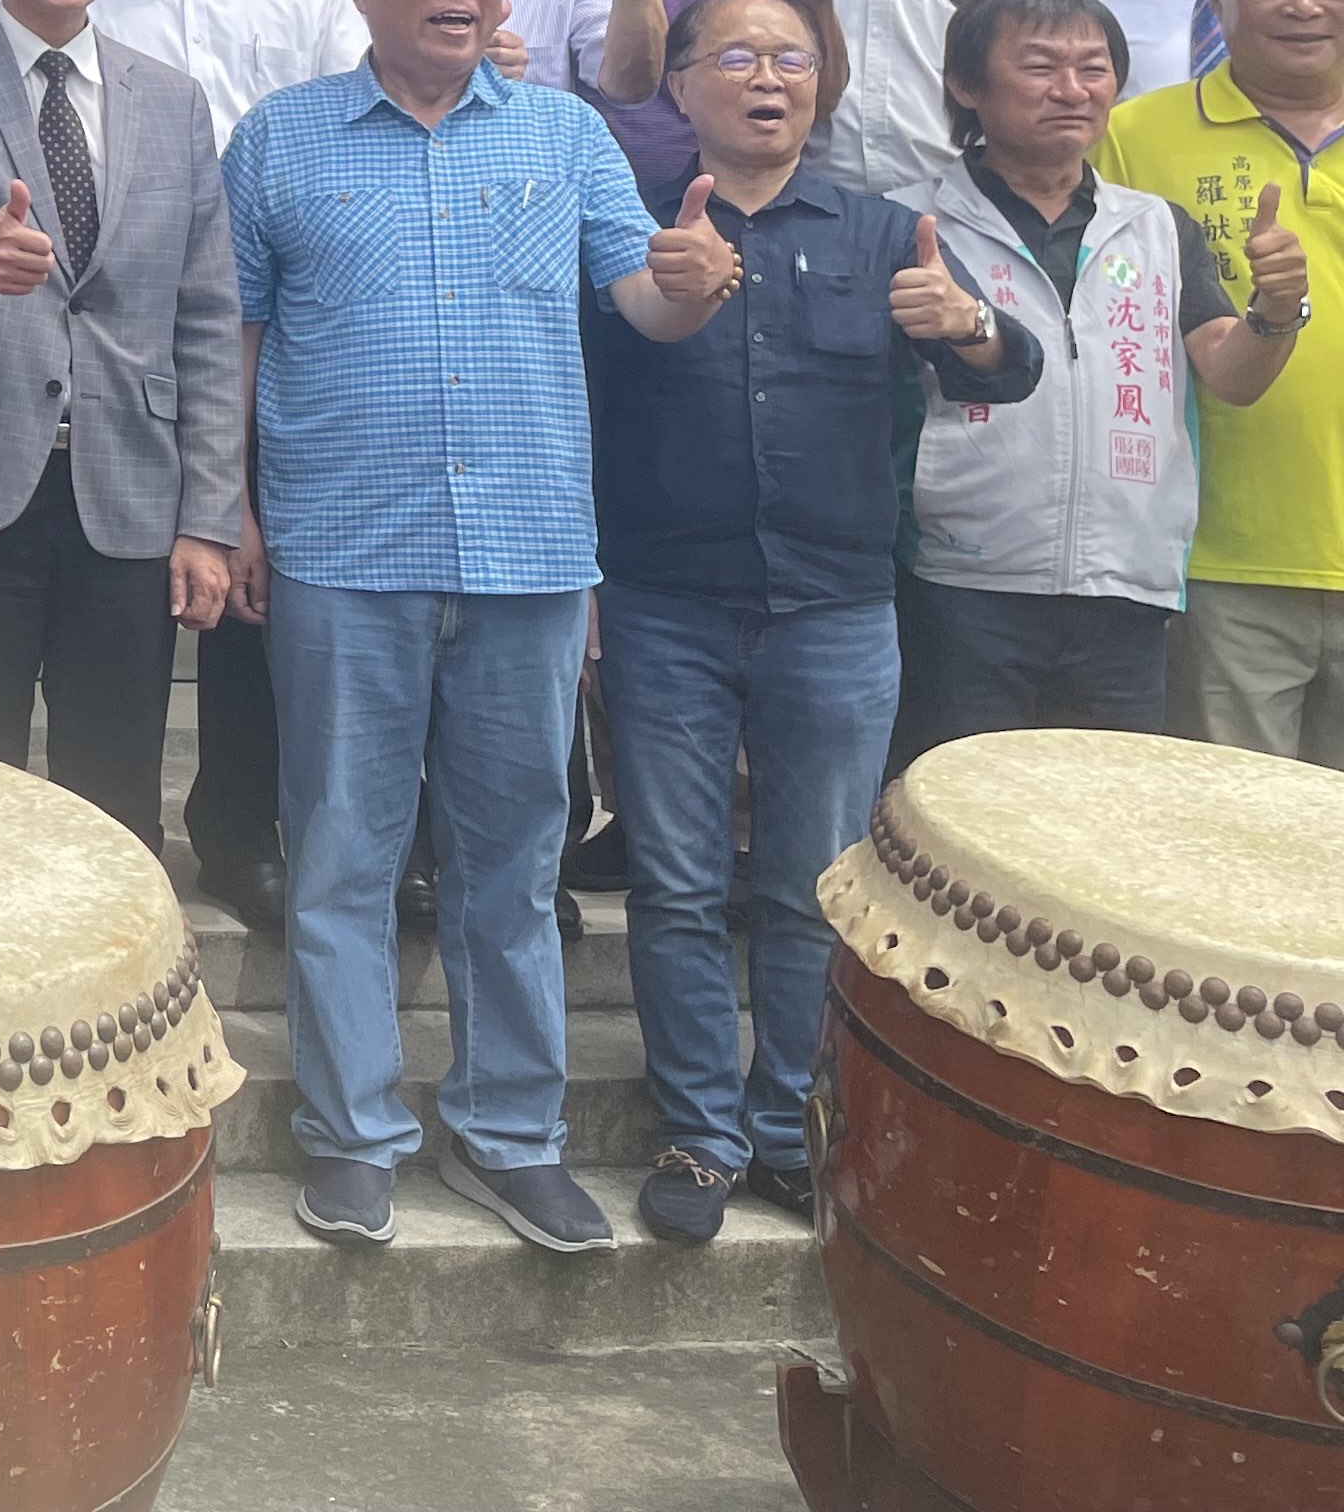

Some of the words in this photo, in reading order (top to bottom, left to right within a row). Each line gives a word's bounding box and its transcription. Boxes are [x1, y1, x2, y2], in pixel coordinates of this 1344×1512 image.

[990, 263, 1020, 320] 副執
[1152, 274, 1172, 394] 臺南市議員
[1106, 294, 1152, 426] 沈家鳳
